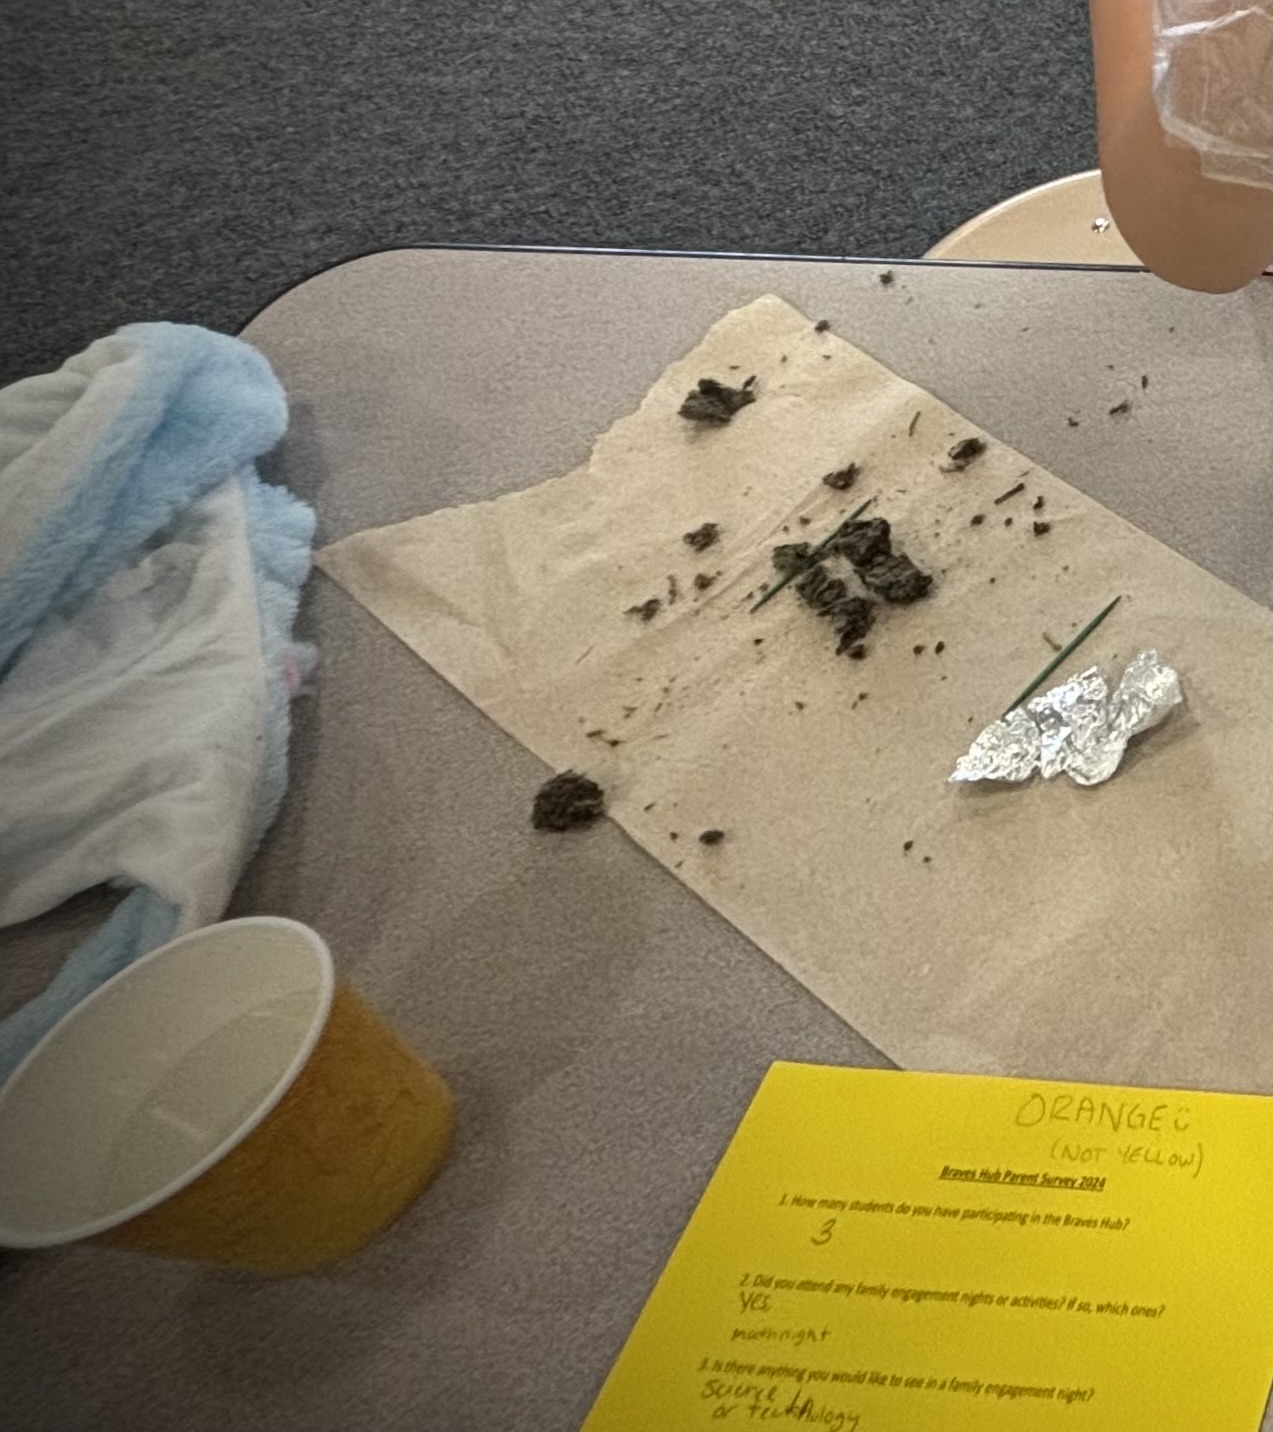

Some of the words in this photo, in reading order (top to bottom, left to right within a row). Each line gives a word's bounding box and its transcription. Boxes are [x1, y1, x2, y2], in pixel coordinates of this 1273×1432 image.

[1015, 1092, 1168, 1133] ORANGE
[939, 1165, 976, 1180] Braves
[978, 1167, 1001, 1182] Hub
[1004, 1170, 1039, 1185] Parent
[1041, 1173, 1078, 1189] Survey
[791, 1195, 817, 1208] How
[818, 1198, 847, 1211] many
[849, 1199, 894, 1214] students
[895, 1202, 911, 1215] do
[912, 1206, 932, 1217] you
[933, 1206, 960, 1219] have
[961, 1206, 1030, 1226] participating
[1031, 1210, 1041, 1223] in
[1042, 1212, 1061, 1226] the
[1063, 1214, 1098, 1228] Braves
[1100, 1217, 1130, 1231] Hub?
[811, 1218, 837, 1246] 3
[753, 1274, 774, 1289] Did
[774, 1278, 796, 1290] you
[796, 1279, 834, 1293] attend
[833, 1282, 854, 1296] any
[855, 1281, 890, 1300] family
[891, 1287, 960, 1303] engagement
[960, 1291, 995, 1308] nights
[996, 1295, 1009, 1306] or
[1010, 1294, 1065, 1310] activities?
[1066, 1297, 1078, 1311] If
[1077, 1300, 1093, 1314] so,
[1096, 1301, 1128, 1316] which
[1130, 1305, 1165, 1318] ones?
[712, 1360, 724, 1373] Is
[724, 1360, 755, 1375] there
[756, 1364, 806, 1383] anything
[806, 1371, 830, 1384] you
[830, 1371, 868, 1385] would
[868, 1371, 889, 1386] like
[889, 1373, 903, 1387] to
[903, 1376, 925, 1390] see
[925, 1376, 938, 1390] in
[948, 1377, 984, 1396] family
[985, 1382, 1057, 1400] engagement
[1057, 1388, 1095, 1404] night?
